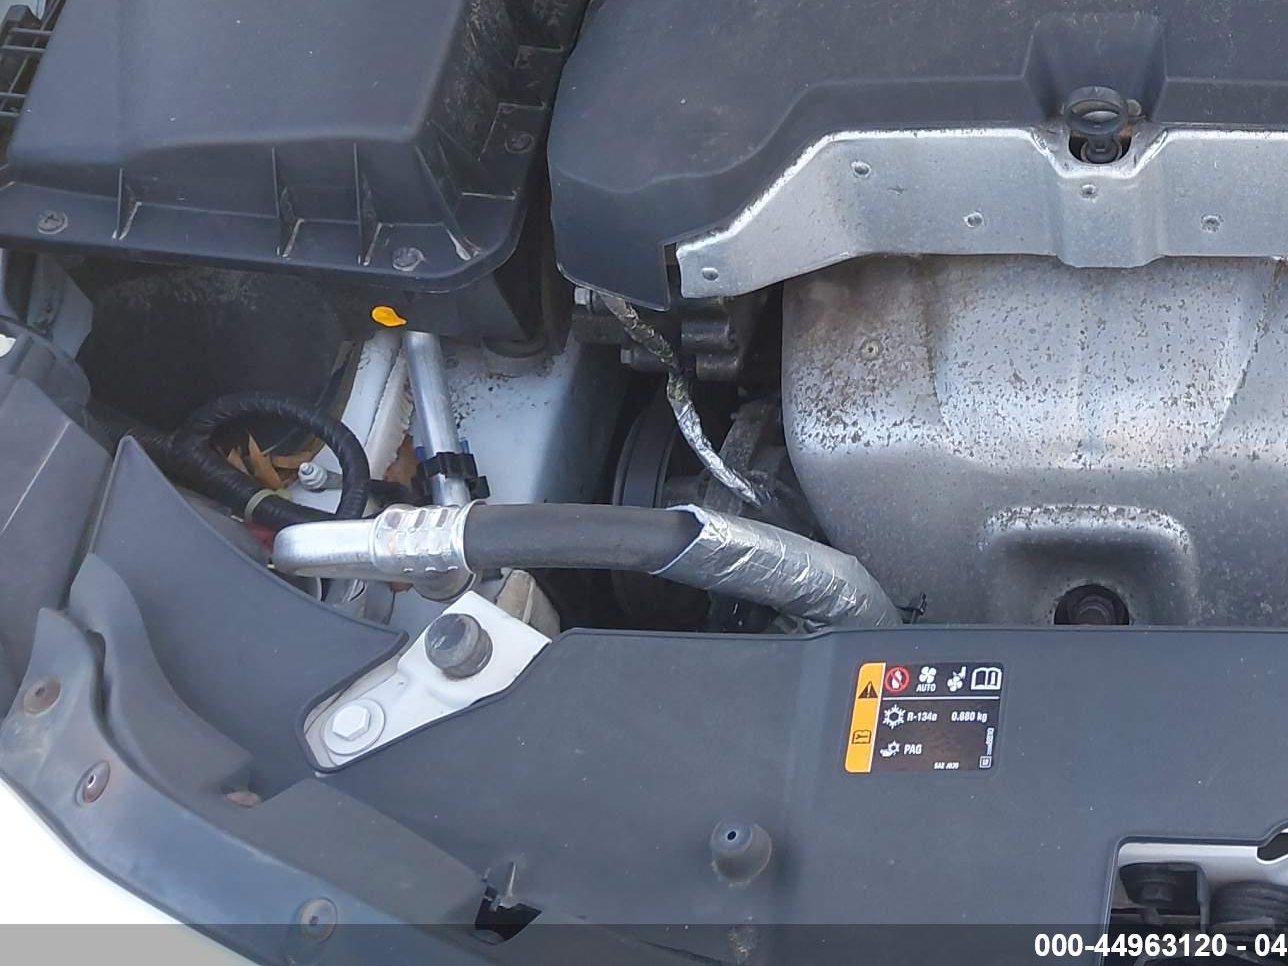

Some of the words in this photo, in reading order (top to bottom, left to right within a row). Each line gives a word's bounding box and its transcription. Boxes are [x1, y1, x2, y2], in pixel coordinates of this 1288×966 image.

[916, 683, 937, 692] AUTO
[906, 711, 938, 722] R-134a
[977, 710, 989, 724] kg
[903, 744, 922, 755] PAG
